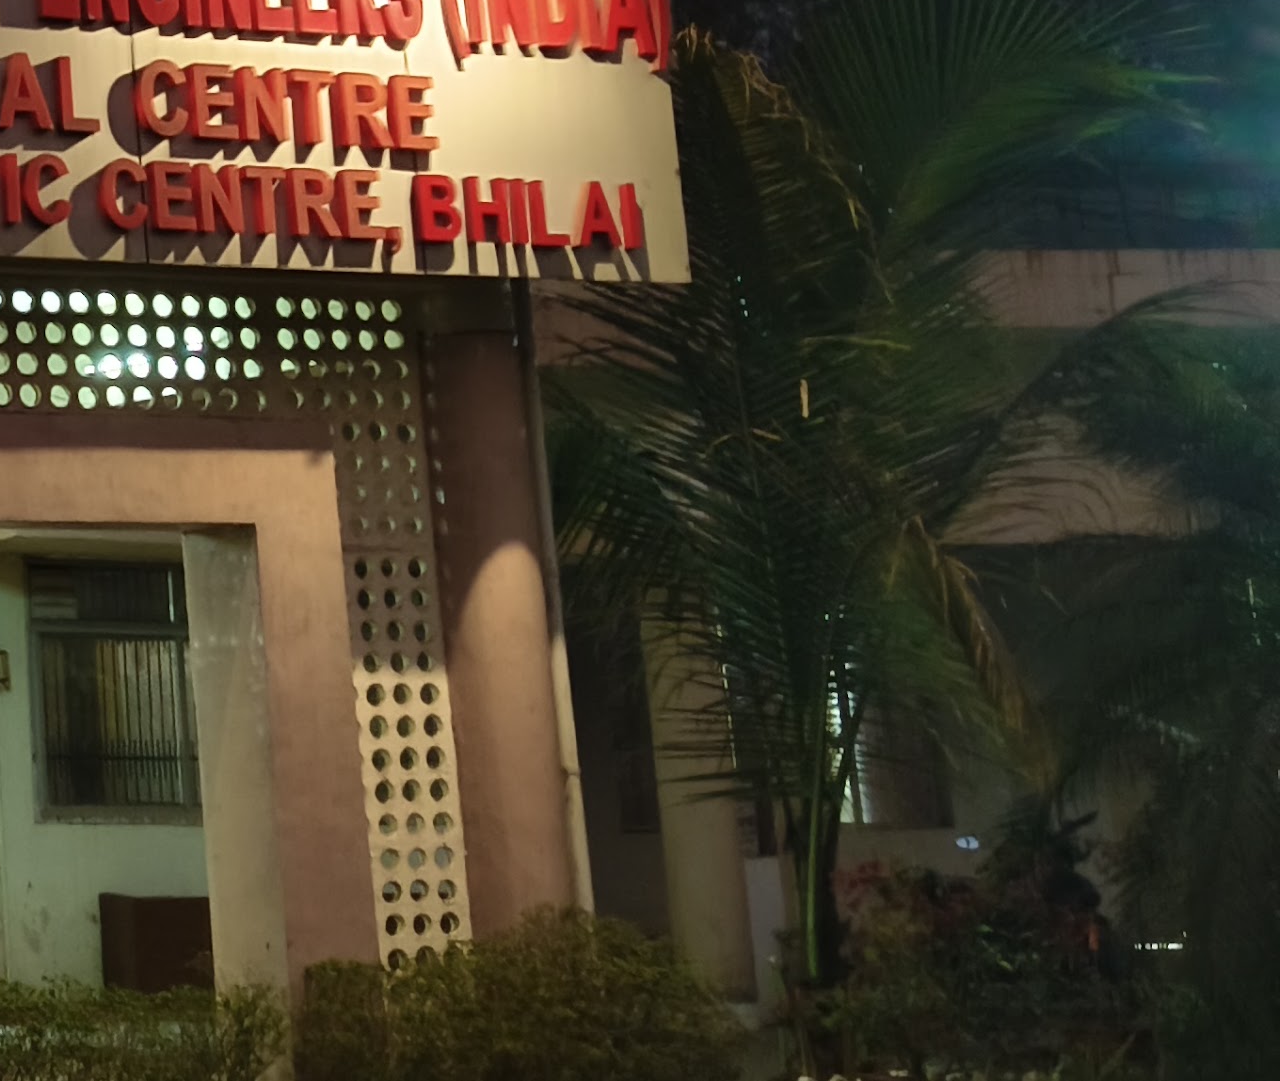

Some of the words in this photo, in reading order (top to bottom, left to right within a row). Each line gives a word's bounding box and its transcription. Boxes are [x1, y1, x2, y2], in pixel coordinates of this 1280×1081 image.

[134, 59, 439, 151] CENTRE
[97, 157, 403, 254] CENTRE,
[413, 175, 644, 251] BHILAI
